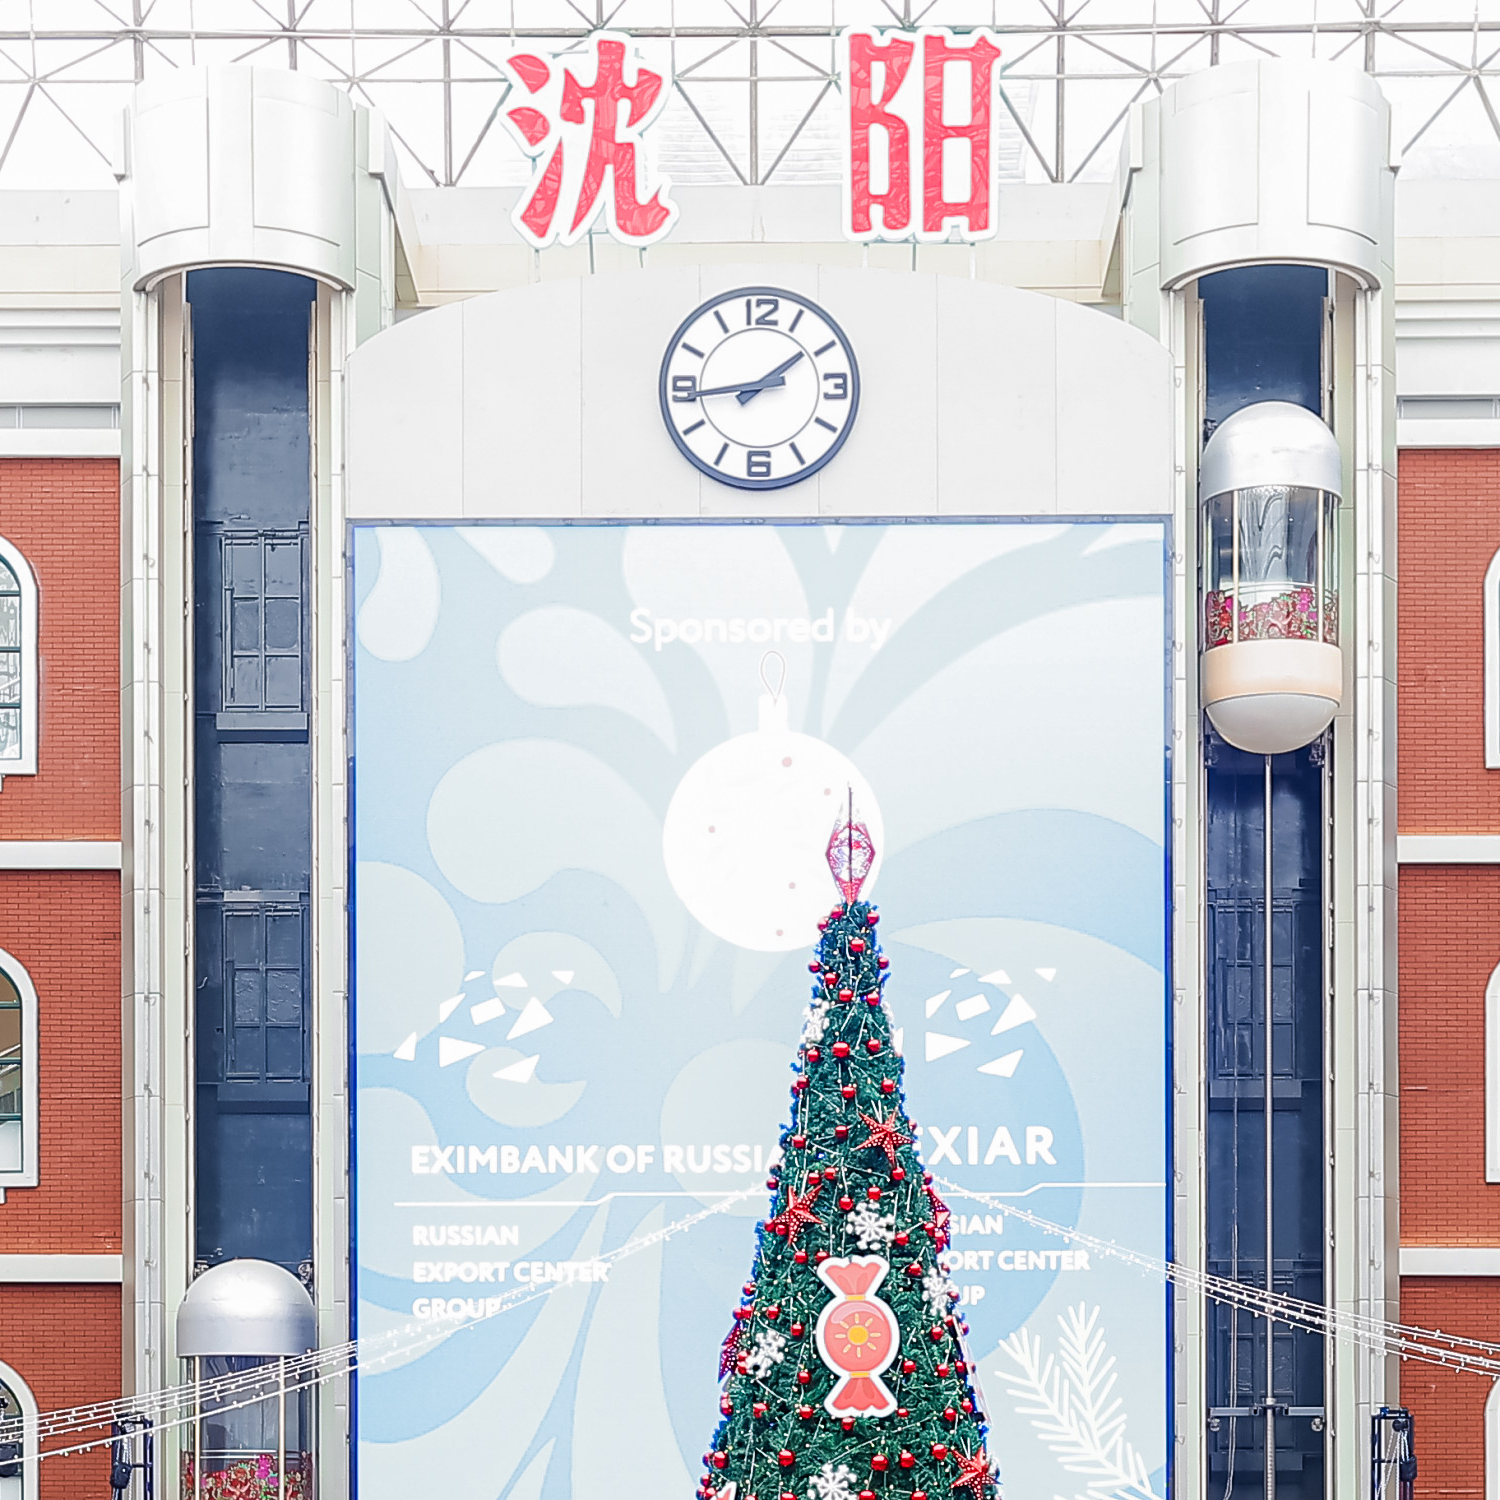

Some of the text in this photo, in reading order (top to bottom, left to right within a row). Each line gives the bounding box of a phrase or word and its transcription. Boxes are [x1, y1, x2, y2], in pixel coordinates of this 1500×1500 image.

[503, 30, 1005, 243] 沈阳
[746, 298, 779, 326] 12
[672, 375, 697, 402] 9
[823, 373, 848, 400] 3
[747, 450, 771, 477] 6
[629, 607, 892, 651] Sponsored by
[411, 1145, 599, 1174] EXIMBANK
[606, 1145, 655, 1174] OF
[412, 1225, 519, 1246] RUSSIAN
[412, 1261, 609, 1283] EXPORT CENTER
[997, 1251, 1090, 1271] CENTER
[412, 1298, 501, 1319] GROUP
